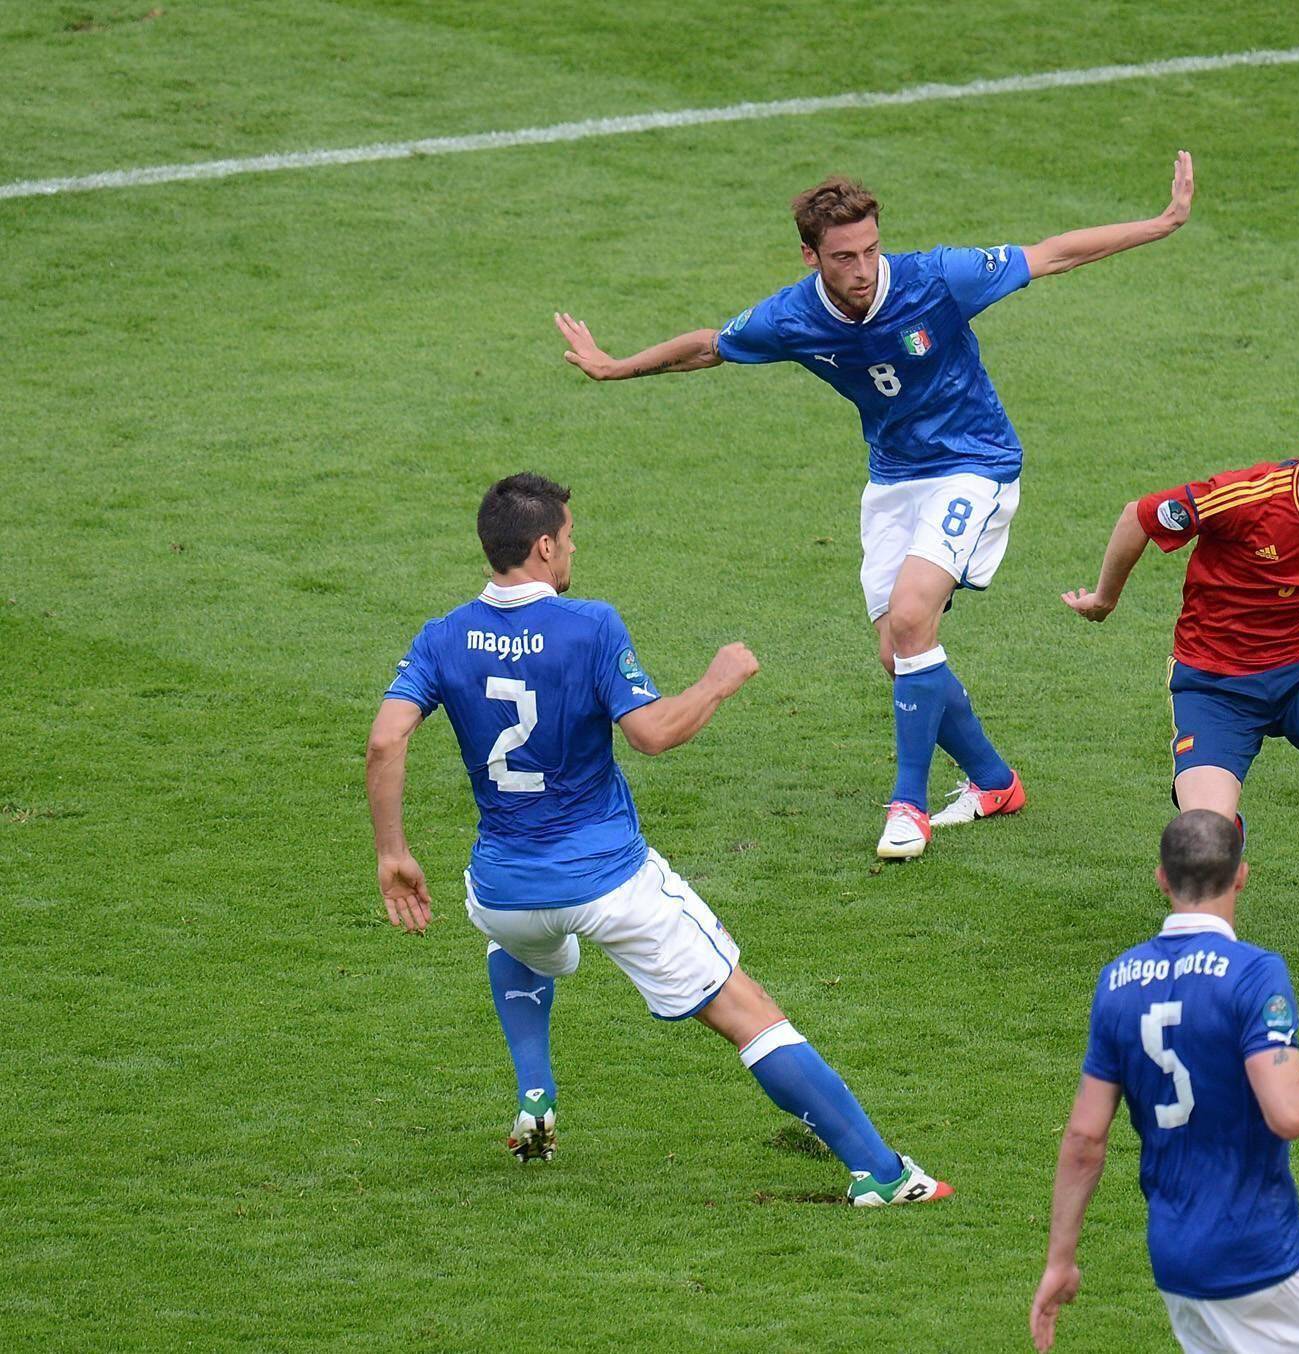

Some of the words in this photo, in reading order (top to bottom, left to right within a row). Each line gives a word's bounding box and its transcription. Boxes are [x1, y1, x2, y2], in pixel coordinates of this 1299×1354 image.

[868, 363, 901, 396] 8
[942, 497, 973, 537] 8
[467, 629, 544, 662] maggio
[486, 676, 545, 791] 2
[1109, 958, 1170, 991] thiago
[1141, 1000, 1195, 1129] 5
